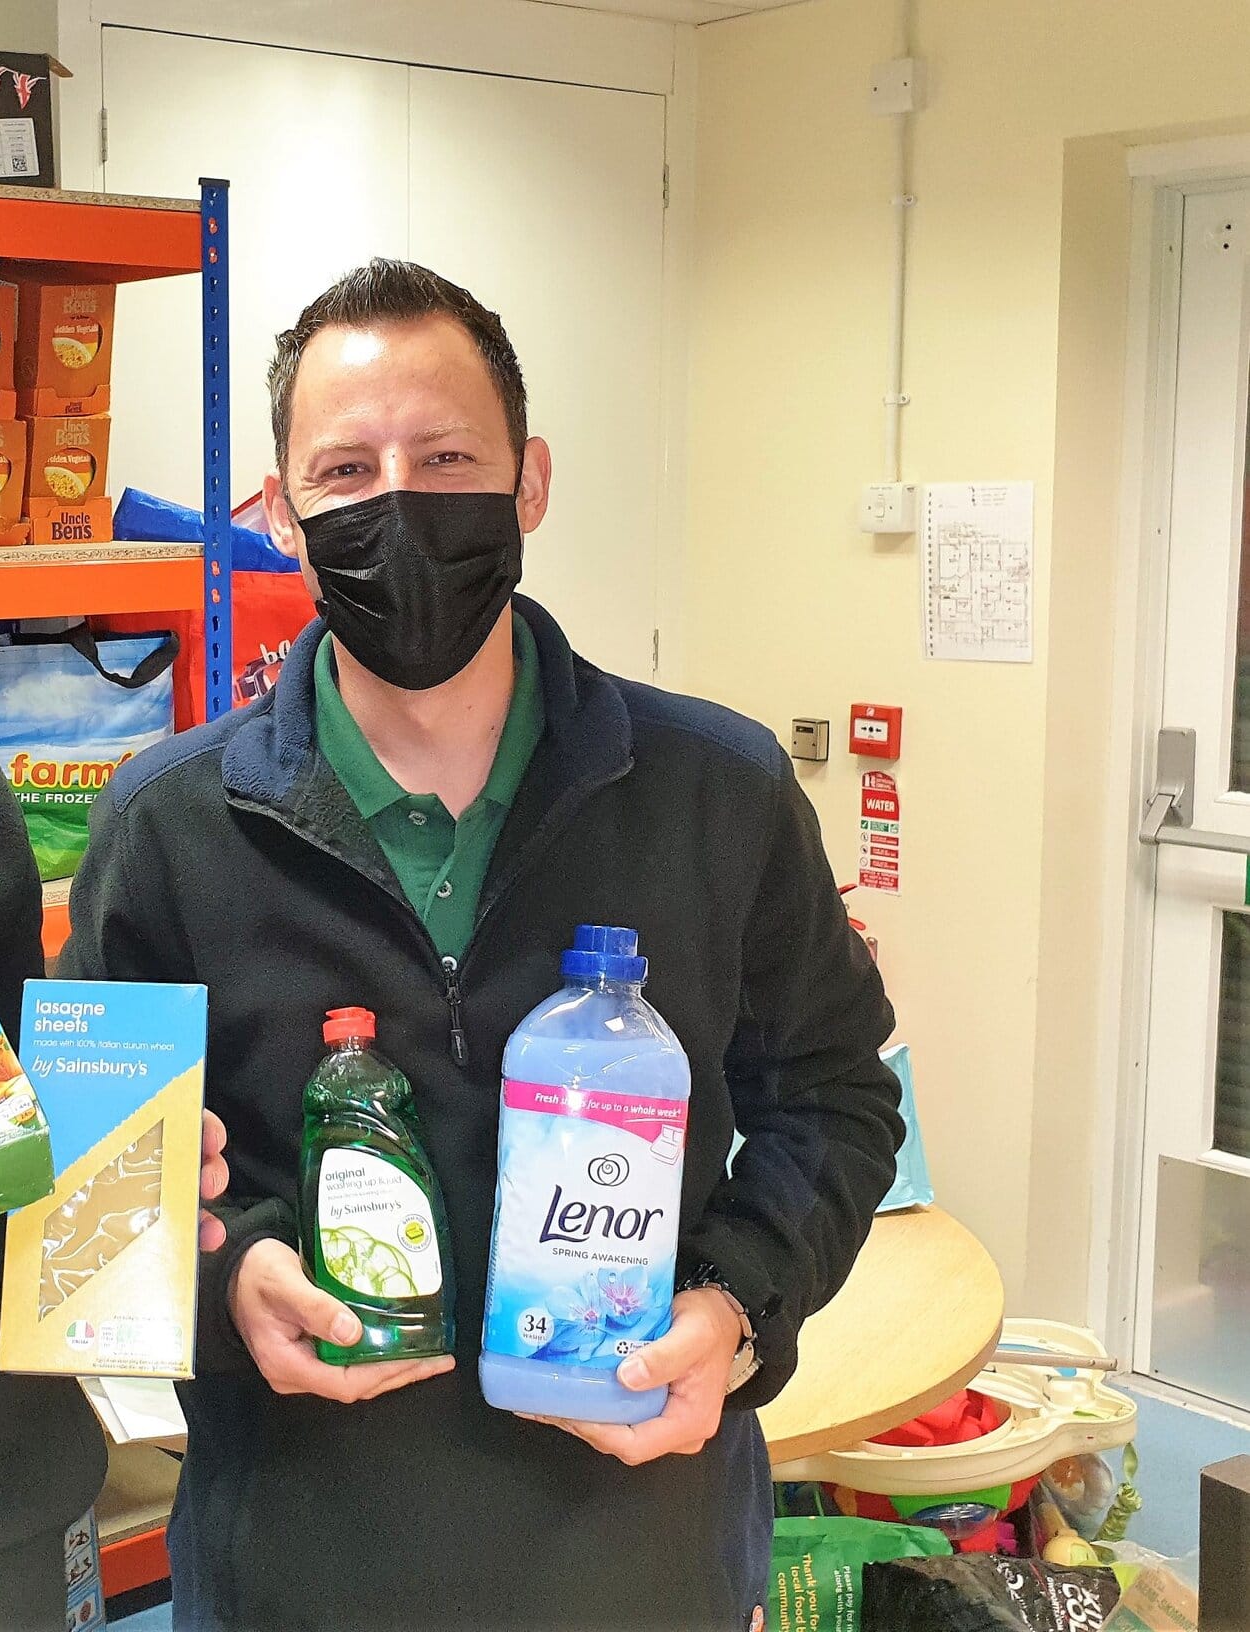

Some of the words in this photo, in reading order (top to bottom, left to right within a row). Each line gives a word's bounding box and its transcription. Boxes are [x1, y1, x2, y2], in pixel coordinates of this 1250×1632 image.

[60, 511, 91, 525] Uncle
[865, 798, 896, 812] WATER
[35, 999, 106, 1018] lasagne
[34, 1016, 88, 1033] sheets
[76, 1039, 96, 1049] 100%
[122, 1041, 149, 1051] durum
[150, 1043, 175, 1052] wheat
[31, 1055, 54, 1078] by
[55, 1057, 149, 1079] Sainsbury's
[535, 1092, 559, 1105] Fresh
[587, 1099, 599, 1111] for
[601, 1102, 612, 1112] up
[613, 1102, 622, 1112] to
[630, 1104, 656, 1116] whole
[325, 1167, 366, 1182] original
[326, 1180, 363, 1191] washing
[364, 1178, 377, 1188] up
[330, 1205, 342, 1220] by
[344, 1199, 402, 1215] Sainsbury's
[539, 1184, 664, 1243] Lenor
[552, 1247, 589, 1260] SPRING
[591, 1252, 649, 1266] AWAKENING
[523, 1314, 547, 1334] 34
[790, 1566, 805, 1593] local
[802, 1553, 817, 1588] Thank
[842, 1565, 853, 1592] Please
[833, 1569, 843, 1594] along
[795, 1596, 806, 1624] food
[806, 1589, 817, 1611] you
[837, 1594, 845, 1614] with
[845, 1593, 853, 1608] pay
[810, 1614, 820, 1632] for
[846, 1609, 855, 1622] for
